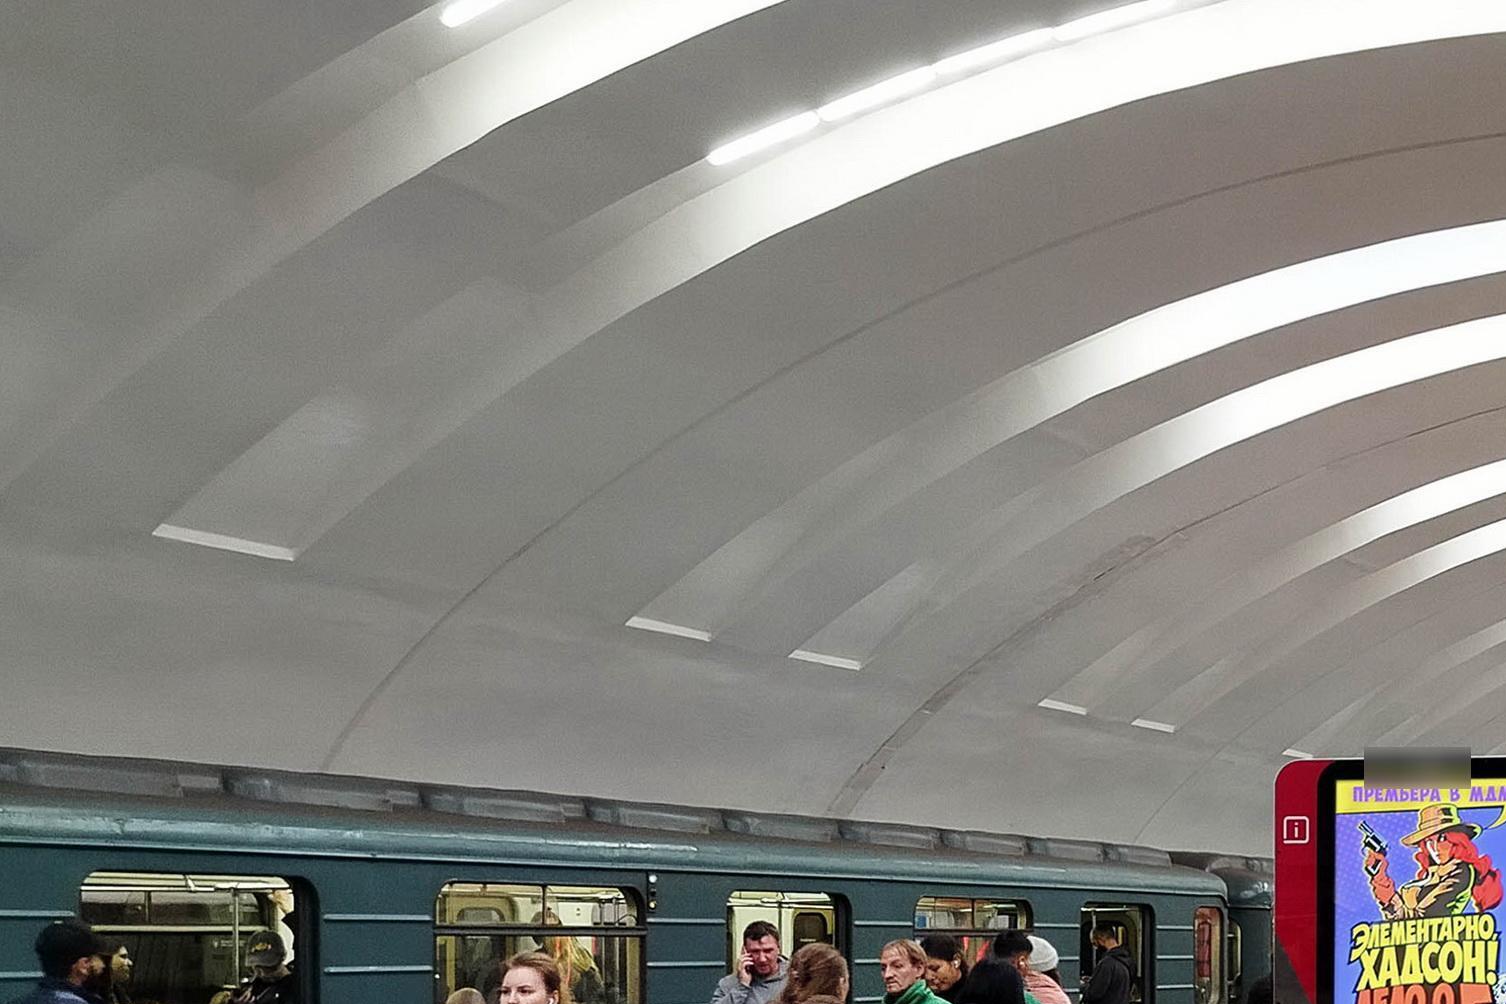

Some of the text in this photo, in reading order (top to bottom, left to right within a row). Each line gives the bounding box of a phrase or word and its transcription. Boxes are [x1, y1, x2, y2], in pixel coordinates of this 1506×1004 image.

[1353, 786, 1441, 802] ПРЕМЬЕРА
[1350, 913, 1499, 963] ЭЛЕМЕНТАРНО,
[1356, 940, 1499, 992] ХАДСОН!
